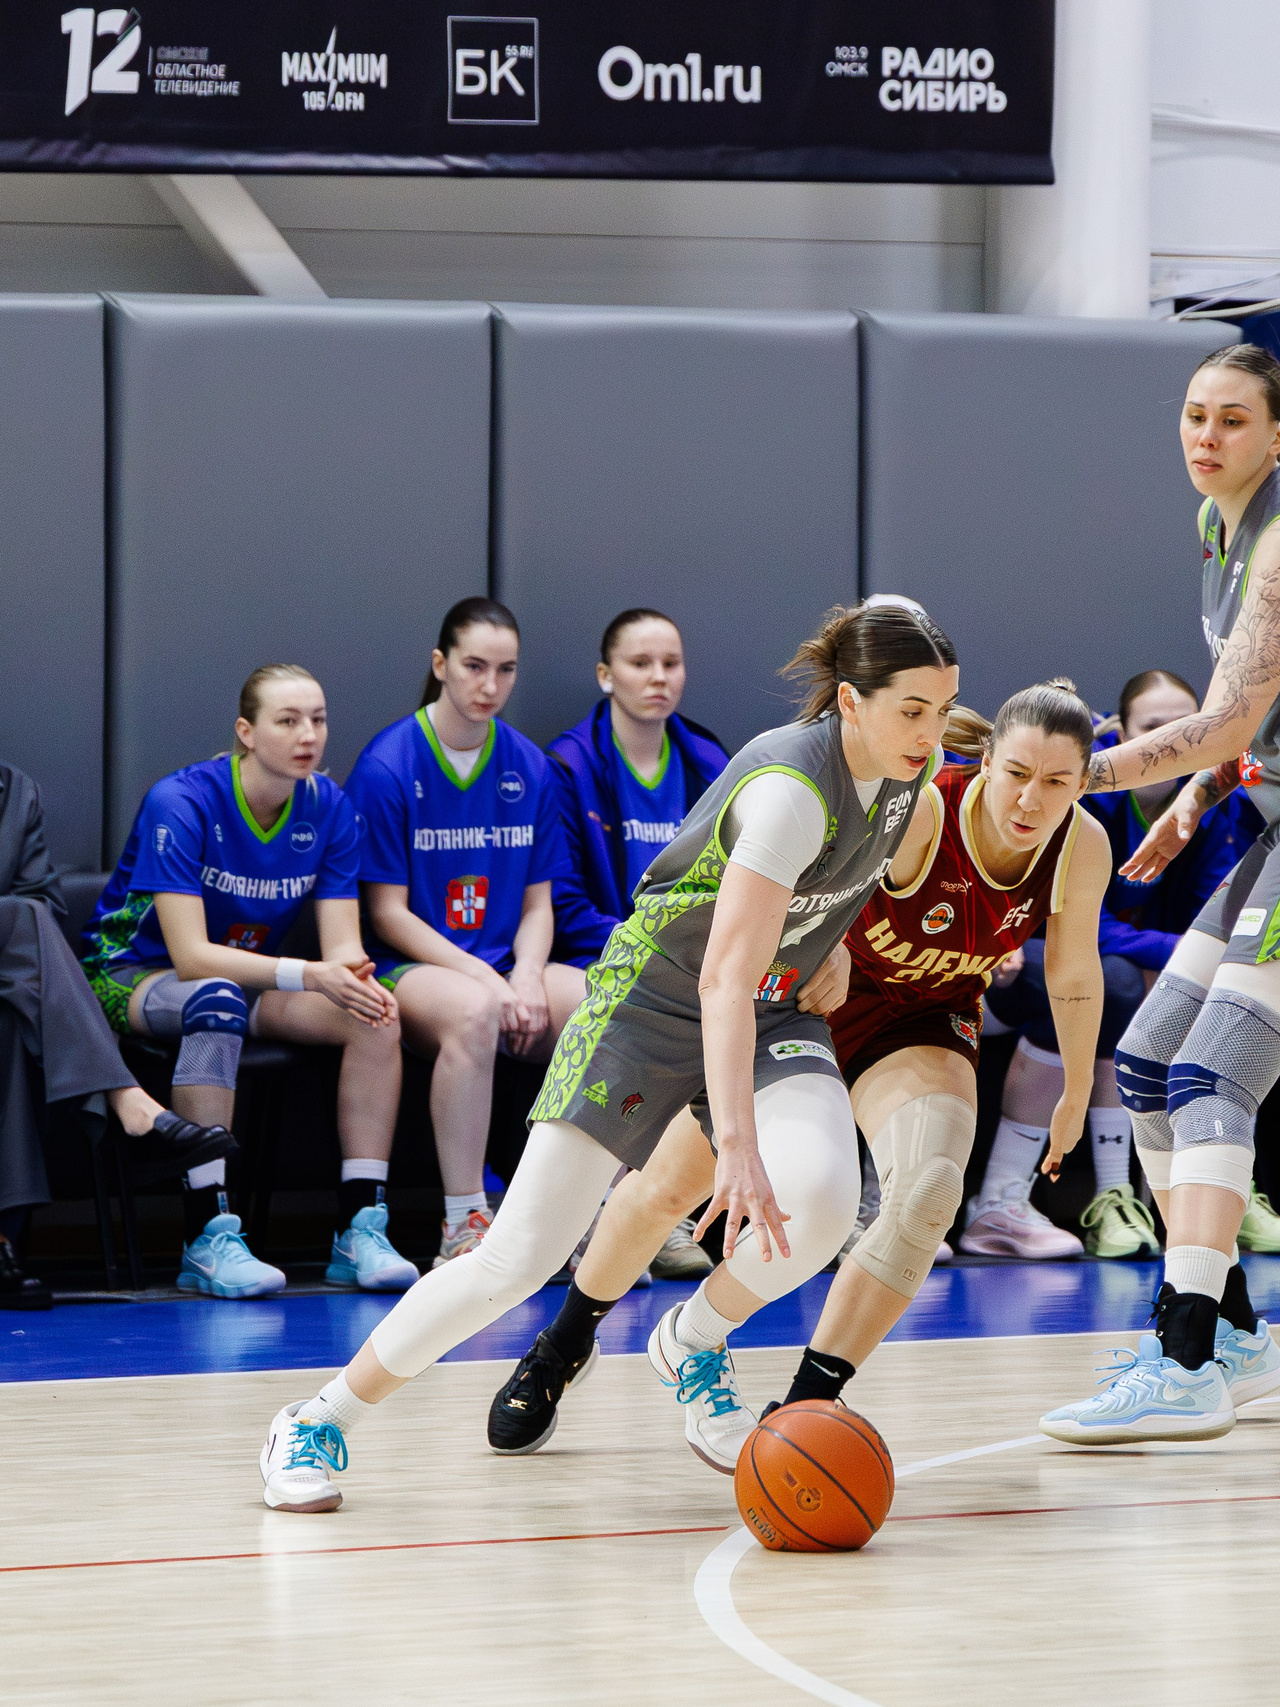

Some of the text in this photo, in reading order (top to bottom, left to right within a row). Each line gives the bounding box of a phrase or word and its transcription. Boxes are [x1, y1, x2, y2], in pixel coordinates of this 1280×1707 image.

[61, 8, 142, 117] 12
[281, 51, 388, 89] MAXIMUM
[824, 61, 869, 78] ОМСК
[835, 46, 869, 61] 103.9
[881, 46, 995, 80] РАДИО
[154, 79, 240, 96] ТЕЛЕВИДЕНИЕ
[155, 63, 226, 79] ОБЛАСТНОЕ
[455, 48, 526, 96] БК
[597, 45, 762, 104] Om1.ru
[878, 79, 1008, 113] СИБИРЬ
[581, 1087, 609, 1110] PEAK
